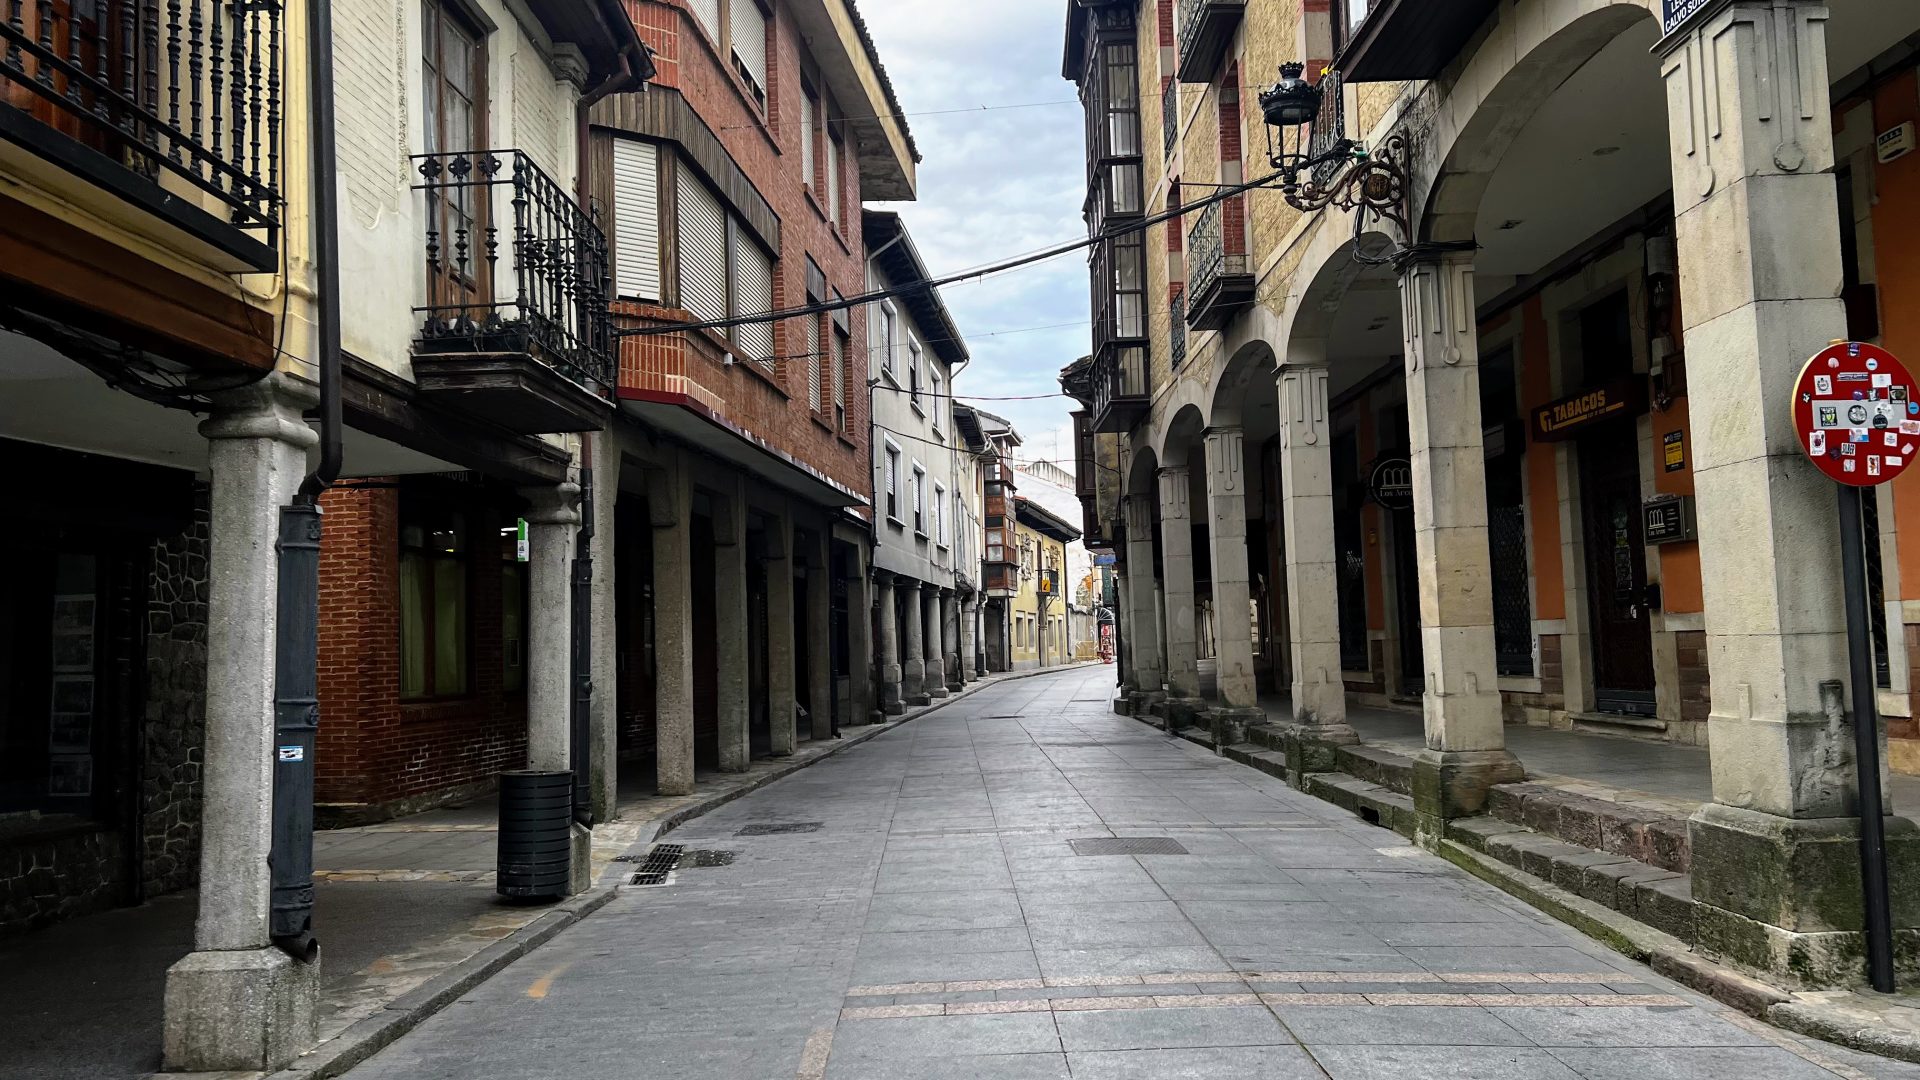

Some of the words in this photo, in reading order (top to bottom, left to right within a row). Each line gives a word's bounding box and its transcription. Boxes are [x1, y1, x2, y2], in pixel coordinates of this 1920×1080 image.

[1665, 6, 1687, 32] CALVO
[1553, 389, 1606, 422] TABACOS
[1396, 489, 1413, 497] Arco
